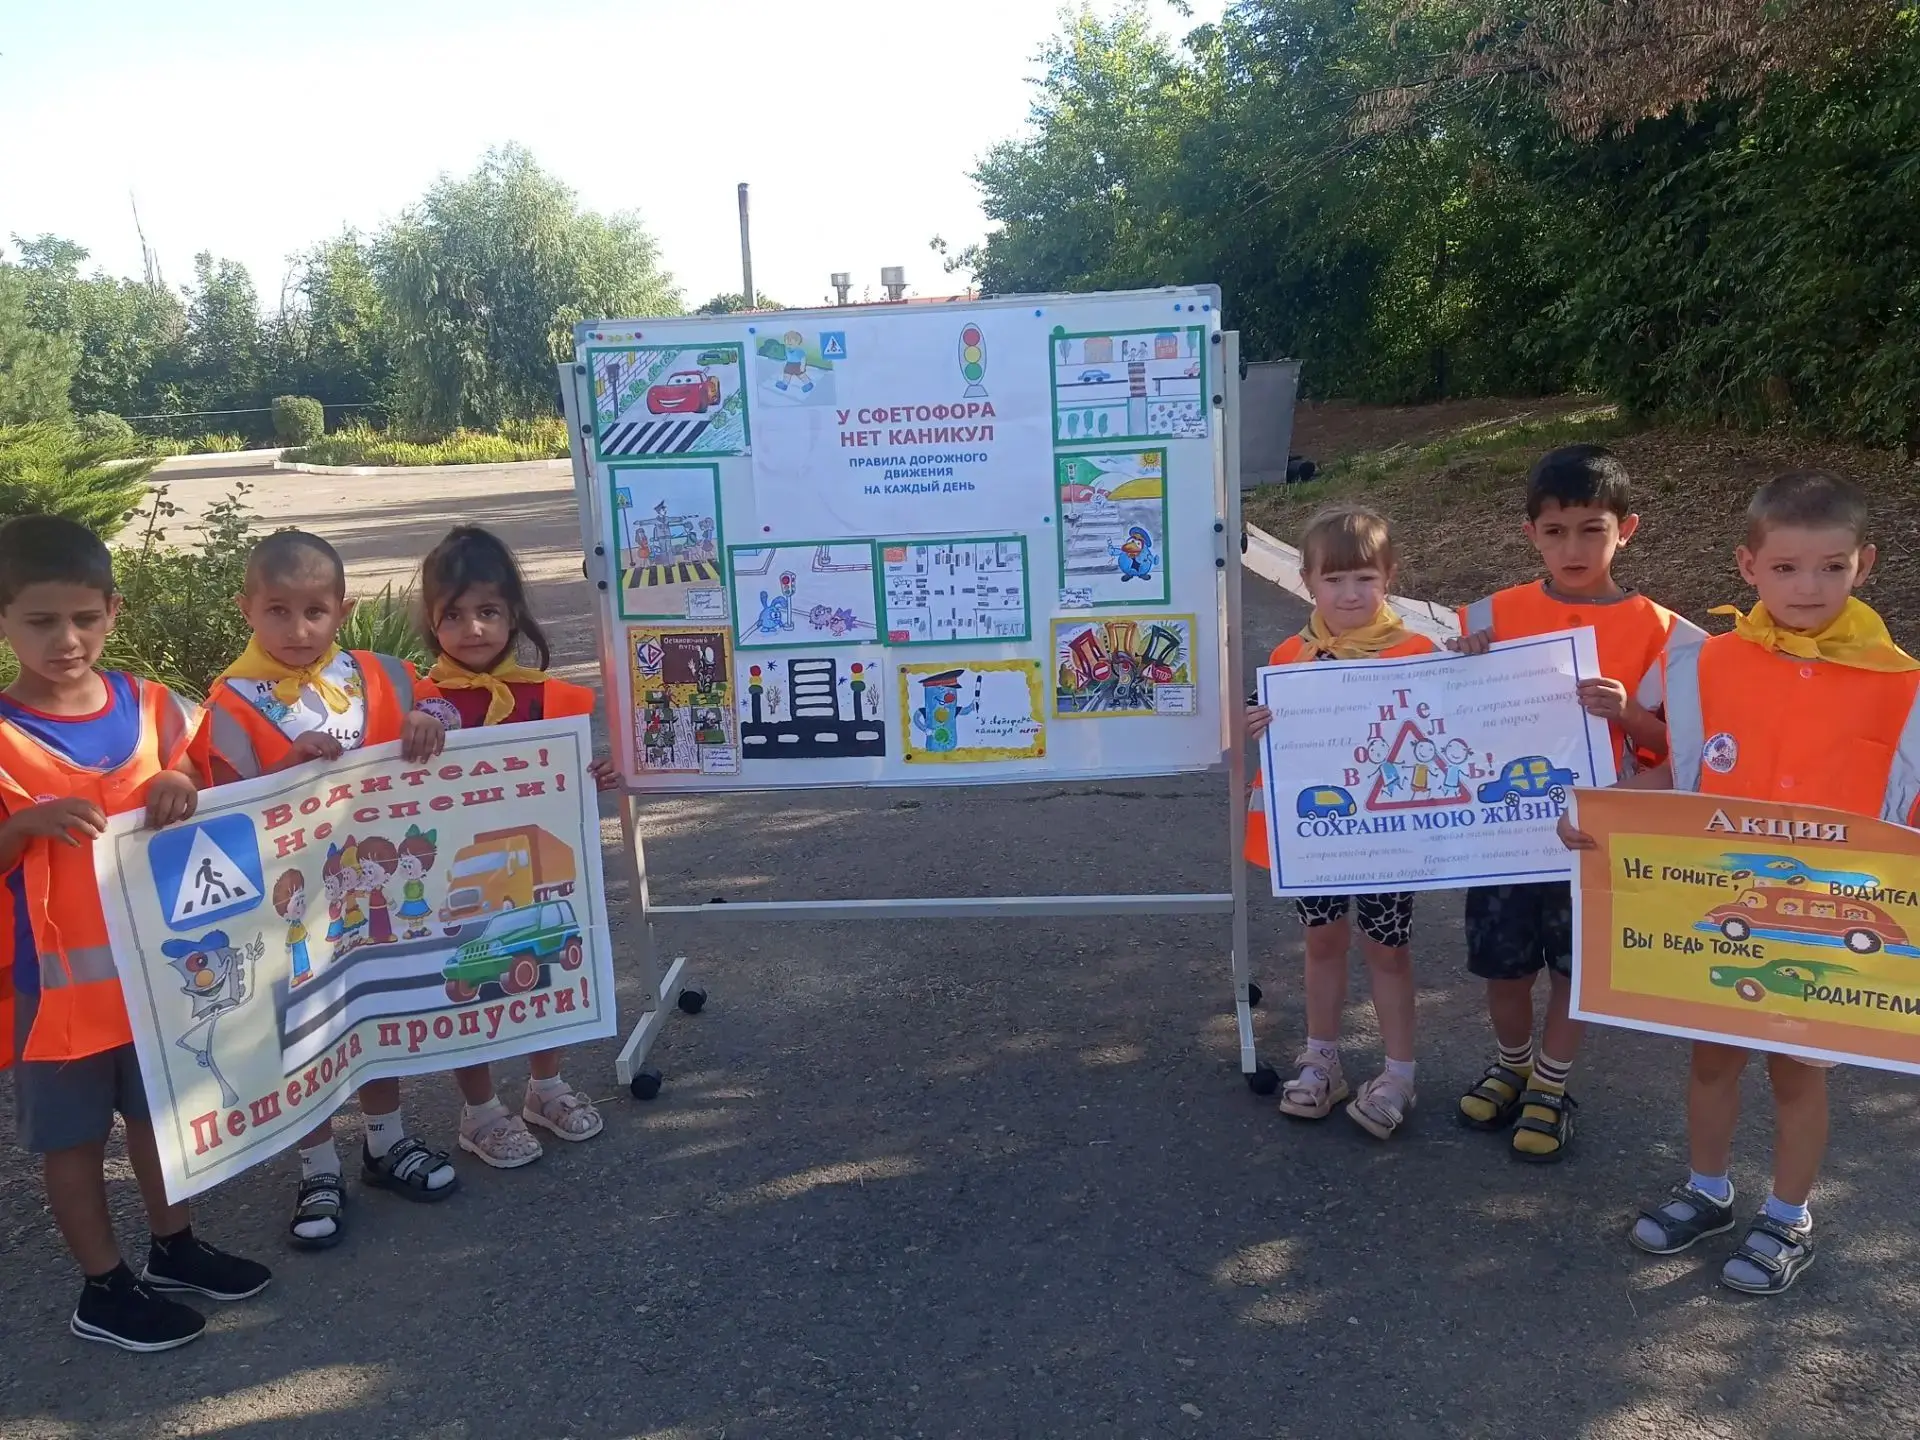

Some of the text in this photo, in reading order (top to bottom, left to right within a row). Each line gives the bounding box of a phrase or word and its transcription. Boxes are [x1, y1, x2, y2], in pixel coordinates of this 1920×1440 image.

[836, 401, 996, 425] У СФЕТОФОРА
[840, 425, 994, 447] НЕТ КАНИКУЛ
[849, 452, 988, 467] ПРАВИЛА ДОРОЖНОГО
[883, 467, 954, 480] ДВИЖЕНИЯ
[864, 481, 976, 494] НА КАЖДЫЙ ДЕНЬ
[995, 623, 1025, 636] ТЕАТ
[328, 727, 360, 740] ELLO
[261, 748, 551, 832] Водитель!
[352, 773, 567, 824] спеши!
[1296, 814, 1407, 839] СОХРАНИ
[1412, 809, 1476, 831] МОЮ
[189, 977, 591, 1157] Пешехода пропусти!
